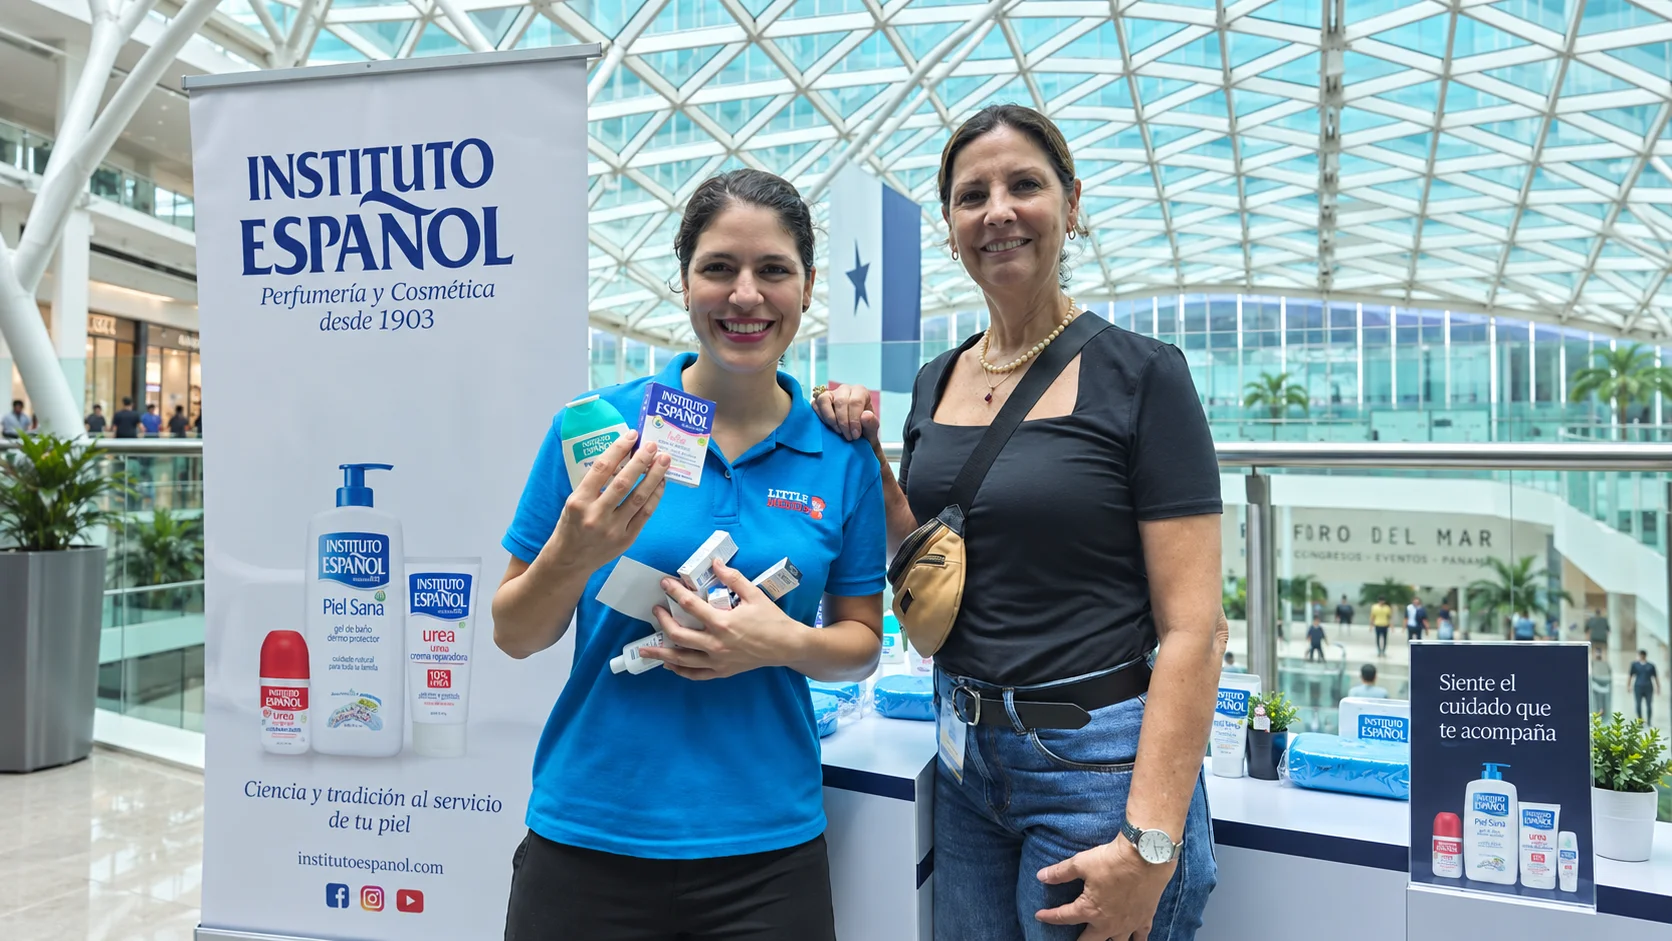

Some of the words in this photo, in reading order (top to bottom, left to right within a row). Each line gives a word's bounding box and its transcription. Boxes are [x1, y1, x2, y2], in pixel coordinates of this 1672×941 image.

[247, 137, 495, 202] INSTITUTO
[240, 191, 514, 276] ESPAÑOL
[260, 283, 367, 309] Perfumería
[371, 287, 384, 307] y
[390, 280, 496, 302] Cosmética
[319, 310, 373, 332] desde
[379, 309, 435, 331] 1903
[662, 390, 709, 414] INSTITUTO
[655, 401, 708, 430] ESPAÑOL
[767, 488, 809, 505] LITTLE
[326, 539, 383, 553] INSTITUTO
[1293, 523, 1352, 543] FORO
[1371, 525, 1416, 546] DEL
[1437, 528, 1492, 548] MAR
[322, 553, 386, 575] ESPAÑOL
[1375, 553, 1428, 564] EVENTOS
[416, 578, 465, 591] INSTITUTO
[323, 597, 347, 615] Piel
[350, 598, 385, 617] Sana
[414, 591, 468, 608] ESPAÑOL
[345, 624, 354, 634] de
[422, 630, 456, 643] urea
[1439, 673, 1496, 692] Siente
[1500, 673, 1517, 692] el
[1216, 699, 1247, 712] PAÑOL
[1439, 697, 1512, 716] cuidado
[1516, 701, 1552, 721] que
[1361, 726, 1407, 740] ESPAÑOL
[1364, 716, 1404, 728] INSTITUTO
[1439, 723, 1457, 739] te
[1461, 723, 1557, 746] acompaña
[244, 780, 307, 801] Ciencia
[310, 787, 322, 806] y
[327, 787, 406, 807] tradición
[411, 790, 428, 808] al
[433, 794, 503, 814] servicio
[328, 811, 350, 829] de
[355, 814, 373, 831] tu
[378, 815, 412, 836] piel
[297, 852, 444, 874] institutoespanol.com
